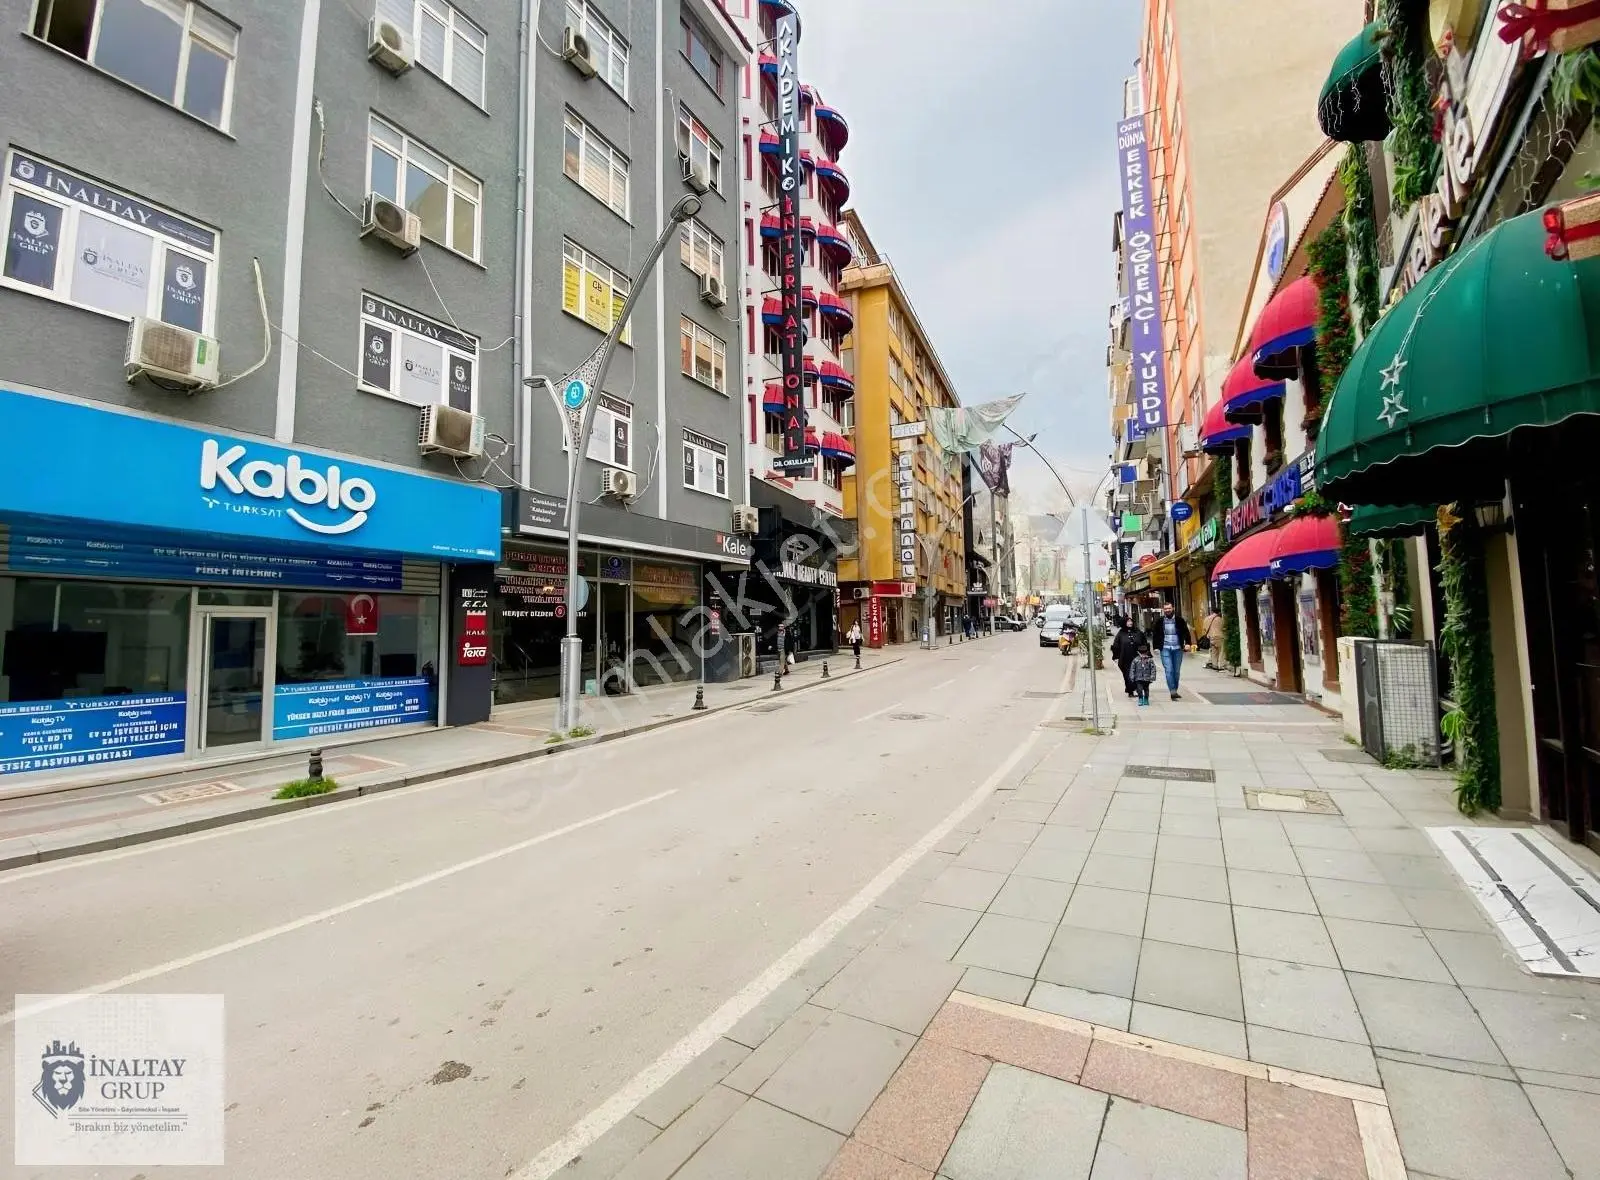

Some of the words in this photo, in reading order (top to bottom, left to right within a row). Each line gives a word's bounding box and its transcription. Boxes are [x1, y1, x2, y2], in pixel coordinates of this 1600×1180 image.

[1119, 118, 1141, 134] ÖZEL
[1118, 132, 1146, 150] DÜNYA
[45, 171, 152, 225] İNALTAY
[1127, 149, 1146, 220] ERKEK
[1139, 351, 1162, 425] YURDU
[200, 438, 377, 513] Kablo
[722, 535, 747, 557] Kale
[0, 760, 32, 773] ETSİZ
[87, 749, 133, 762] NOKTASI
